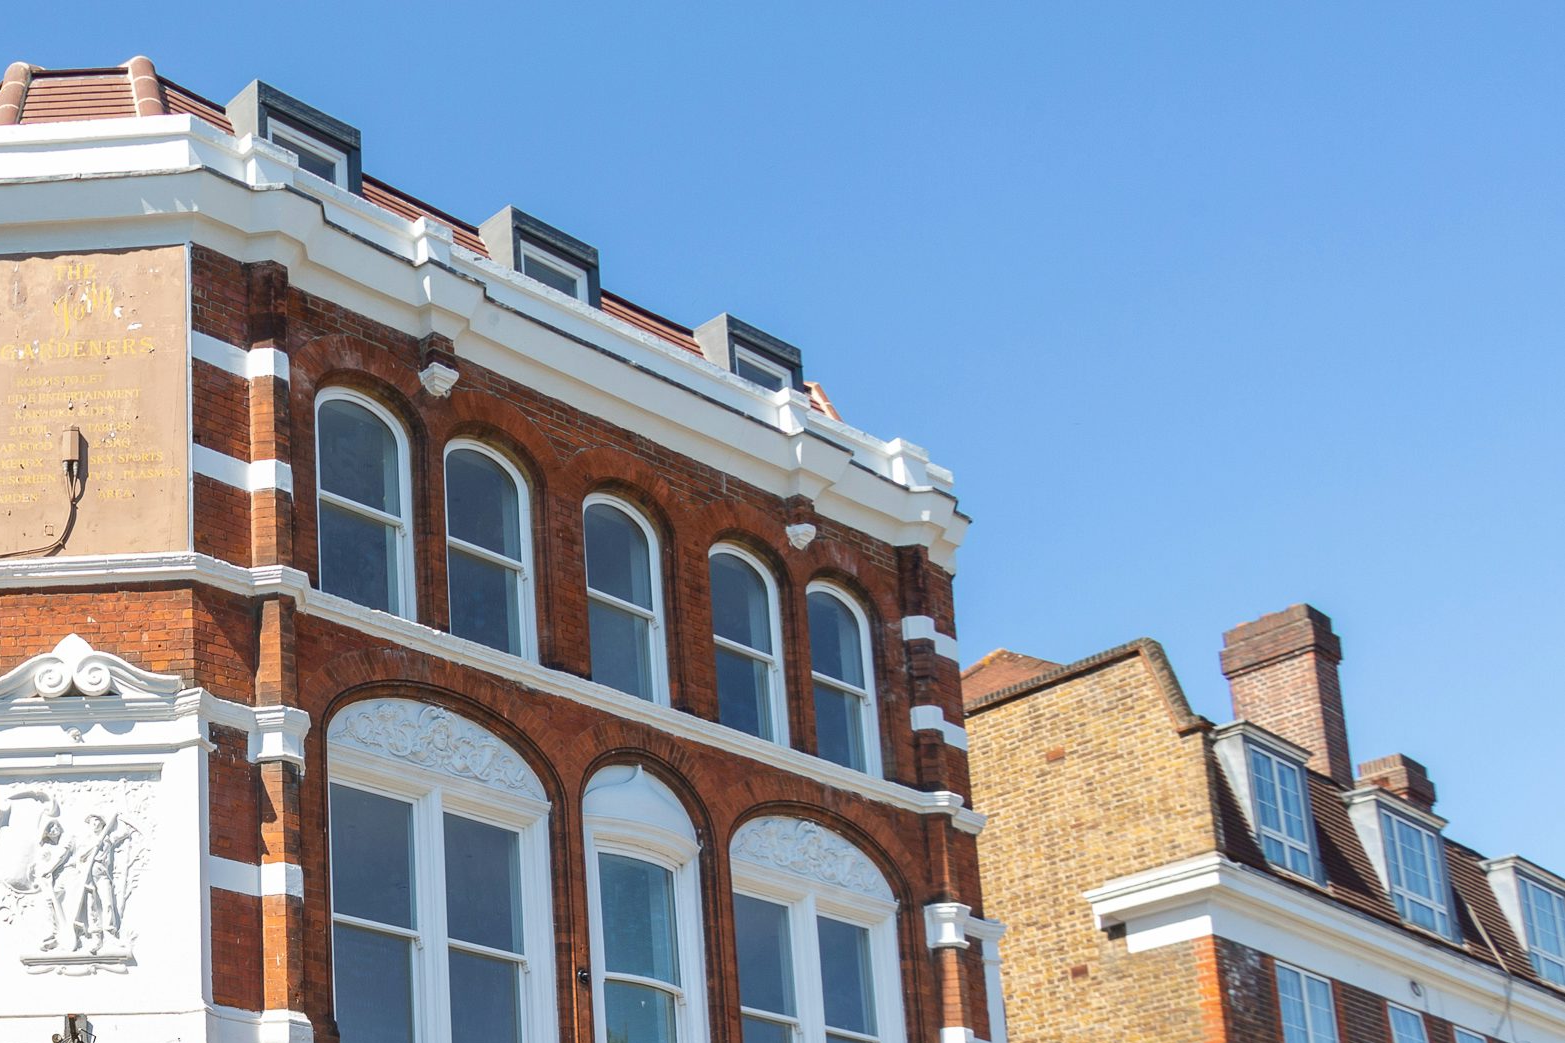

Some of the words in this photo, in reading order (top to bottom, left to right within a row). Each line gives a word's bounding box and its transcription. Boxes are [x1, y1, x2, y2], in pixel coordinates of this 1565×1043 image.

[53, 263, 96, 281] THE
[0, 336, 155, 361] GARDENERS
[64, 374, 79, 386] TO
[81, 374, 105, 385] LET
[38, 388, 142, 403] ENTERTAINMENT
[90, 454, 115, 465] SKY
[117, 451, 164, 464] SPORTS
[8, 473, 57, 486] SCREEN
[98, 488, 131, 499] AREA
